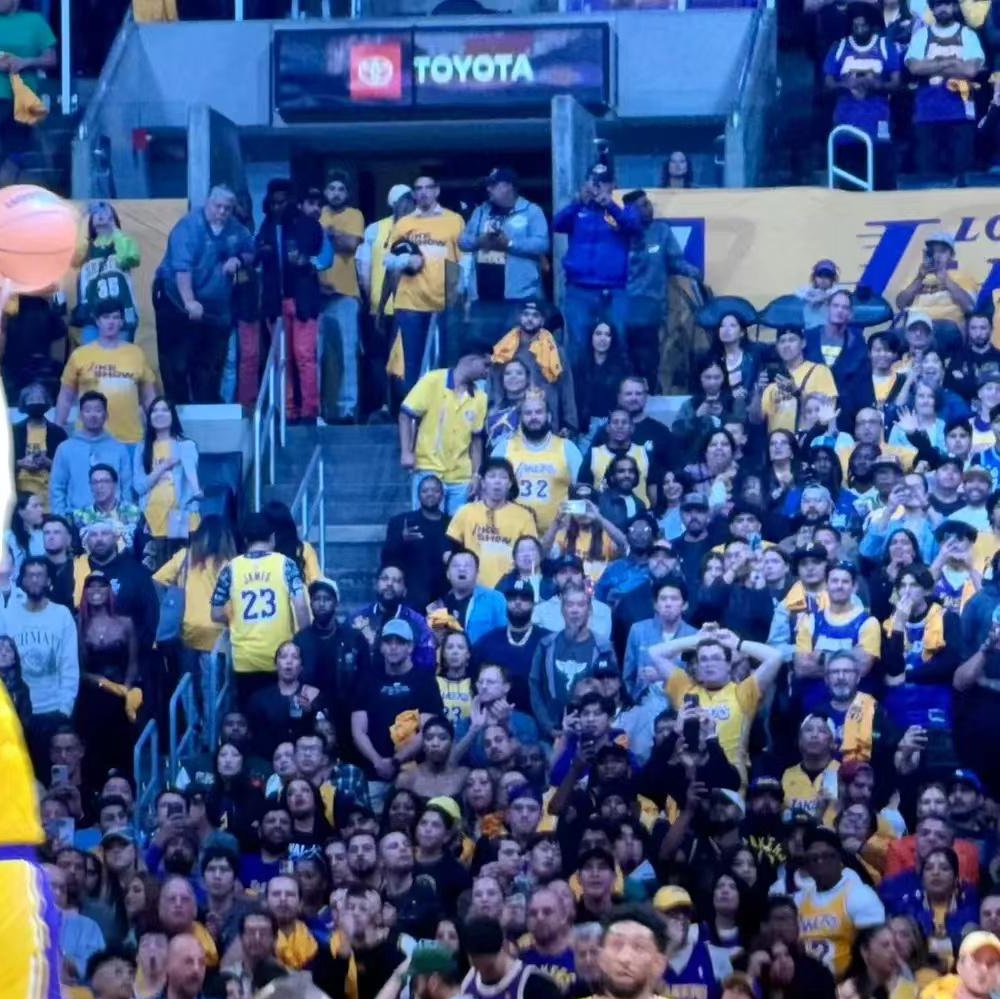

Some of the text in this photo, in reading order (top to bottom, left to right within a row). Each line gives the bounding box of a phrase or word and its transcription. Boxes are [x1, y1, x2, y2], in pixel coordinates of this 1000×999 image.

[413, 53, 535, 84] TOYOTA
[519, 479, 549, 499] 32
[241, 588, 277, 620] 23
